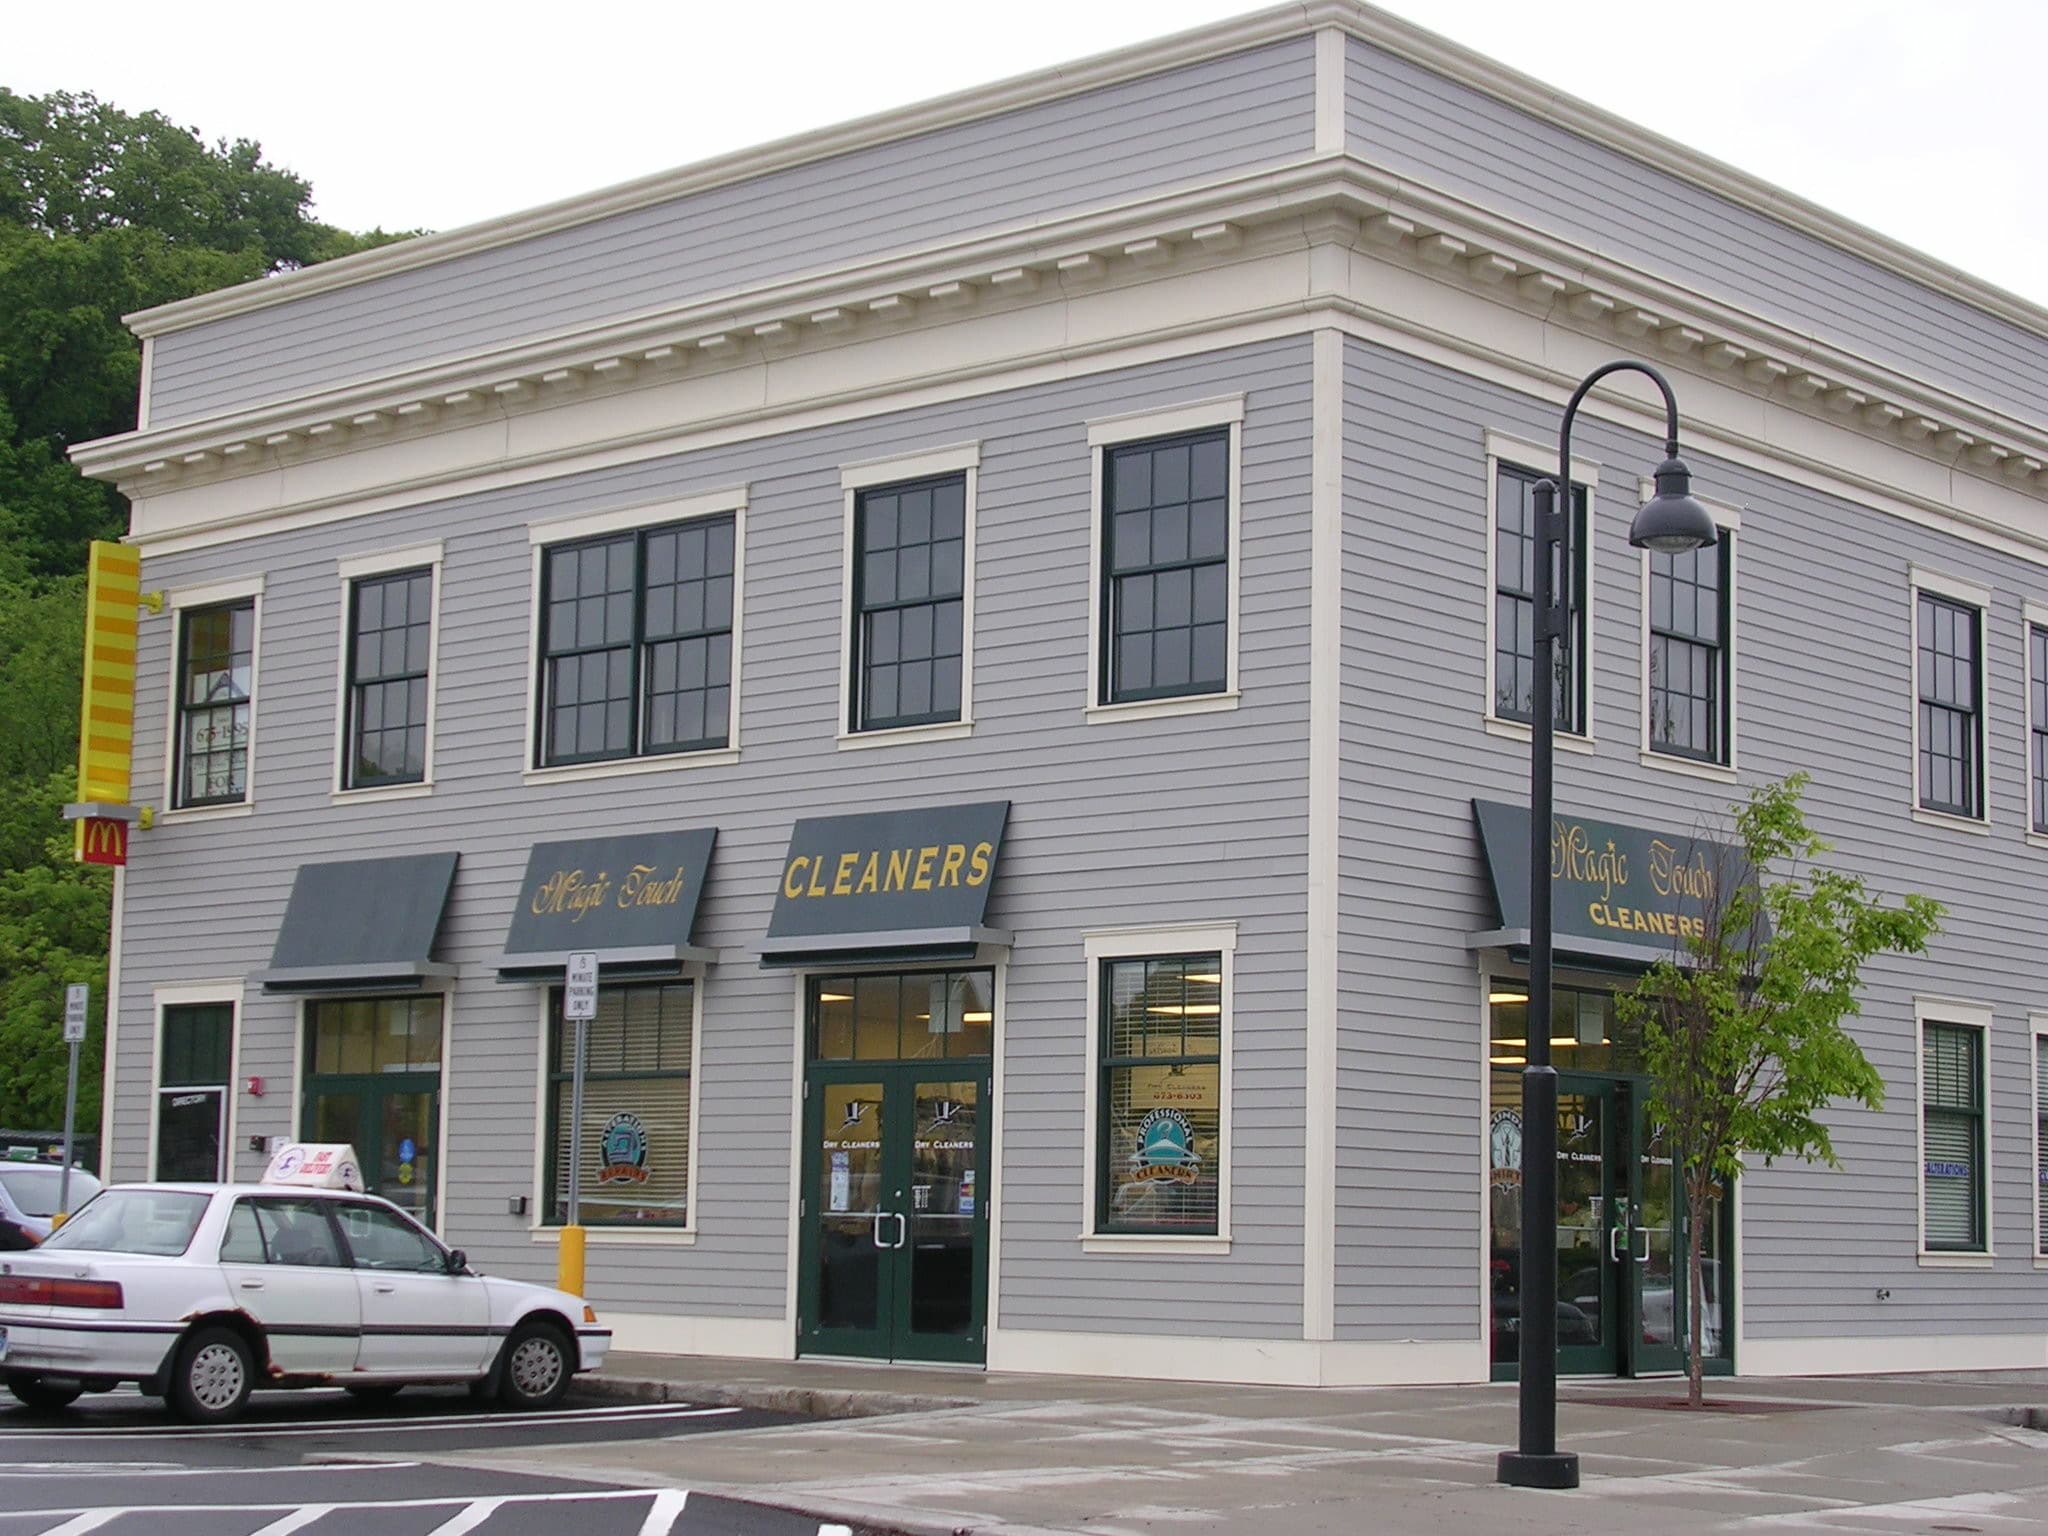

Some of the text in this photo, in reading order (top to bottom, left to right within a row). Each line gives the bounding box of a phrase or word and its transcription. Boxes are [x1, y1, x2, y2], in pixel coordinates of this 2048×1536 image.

[784, 842, 993, 899] CLEANERS
[1552, 820, 1715, 901] Magic Touch
[532, 864, 685, 923] Magic Touch
[1589, 902, 1706, 938] CLEANERS
[1137, 1109, 1193, 1144] PROFESSIONAL
[823, 1141, 881, 1149] DRY CLEANERS
[914, 1141, 974, 1149] DRY CLEANERS
[1136, 1165, 1192, 1180] CLEANERS
[1925, 1162, 1969, 1177] ALTERATIONS
